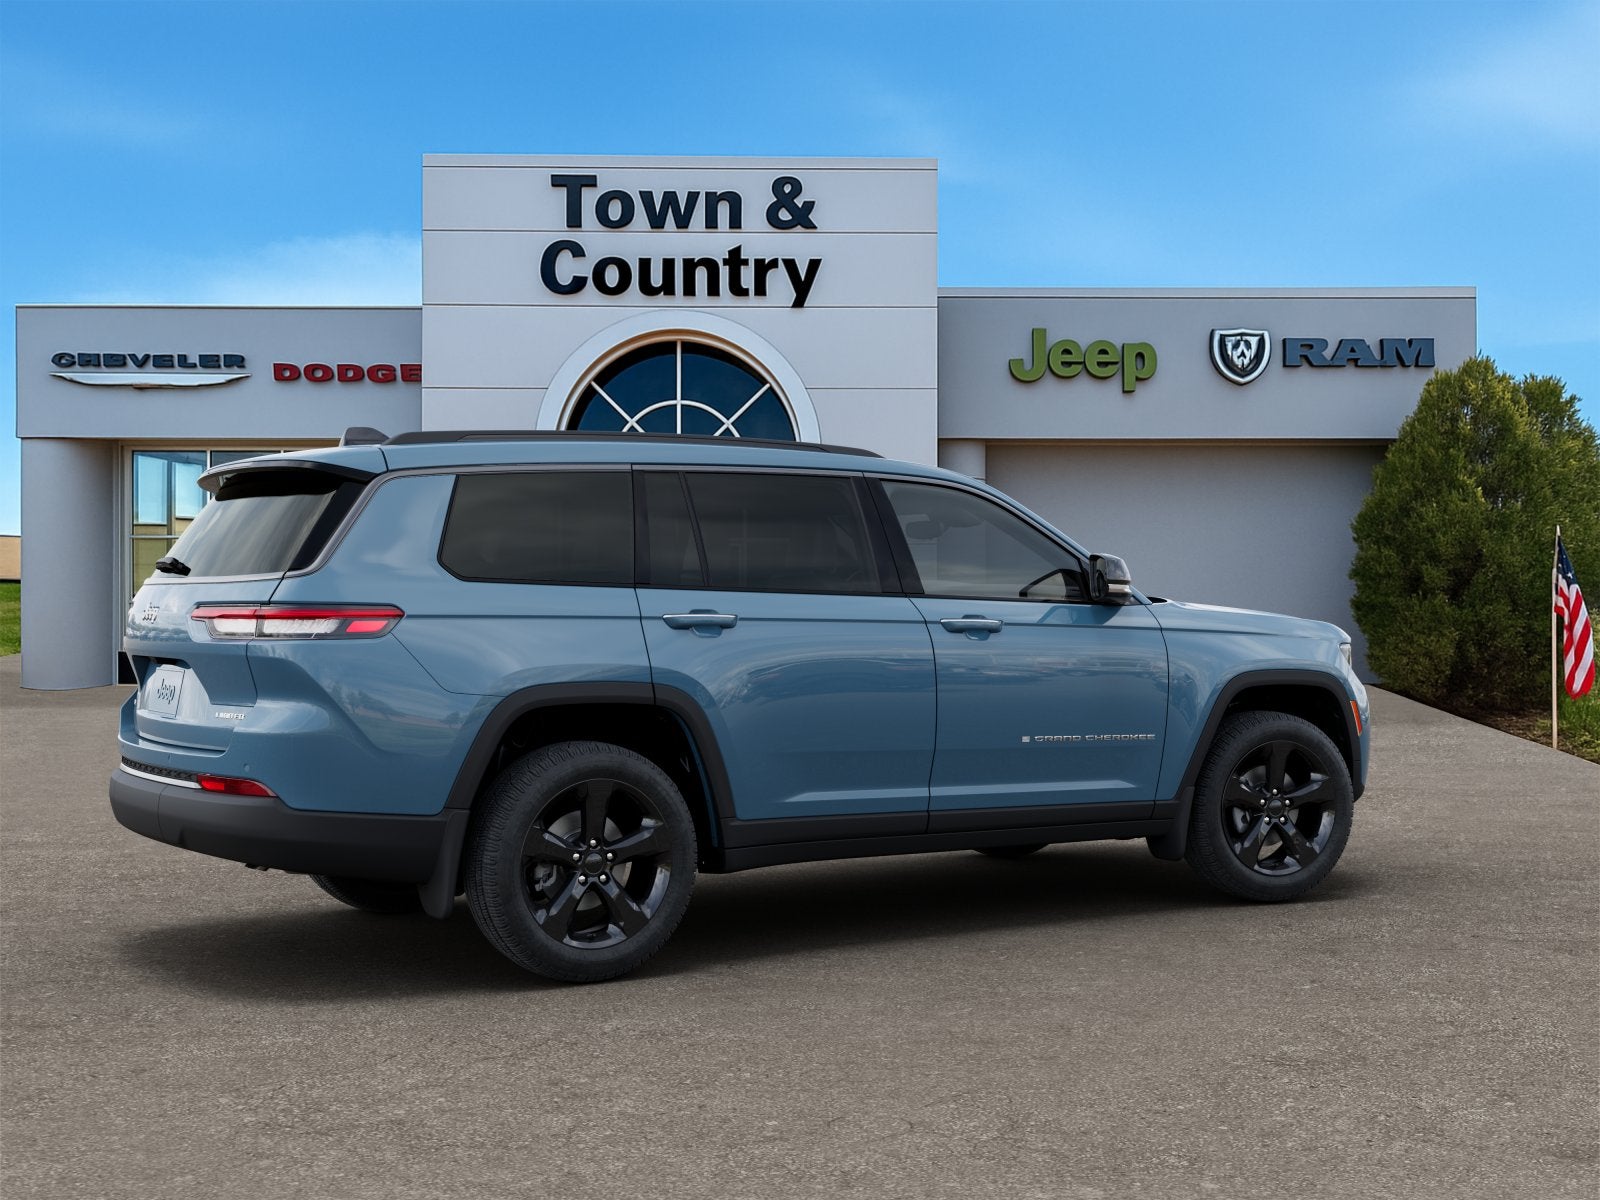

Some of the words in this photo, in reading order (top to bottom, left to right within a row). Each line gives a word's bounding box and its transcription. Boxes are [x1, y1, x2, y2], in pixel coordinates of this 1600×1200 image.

[550, 174, 743, 230] Town
[766, 176, 818, 230] &
[540, 239, 823, 308] Country
[273, 363, 422, 383] DODGE
[1008, 328, 1158, 393] Jeep
[1282, 337, 1436, 368] RAM
